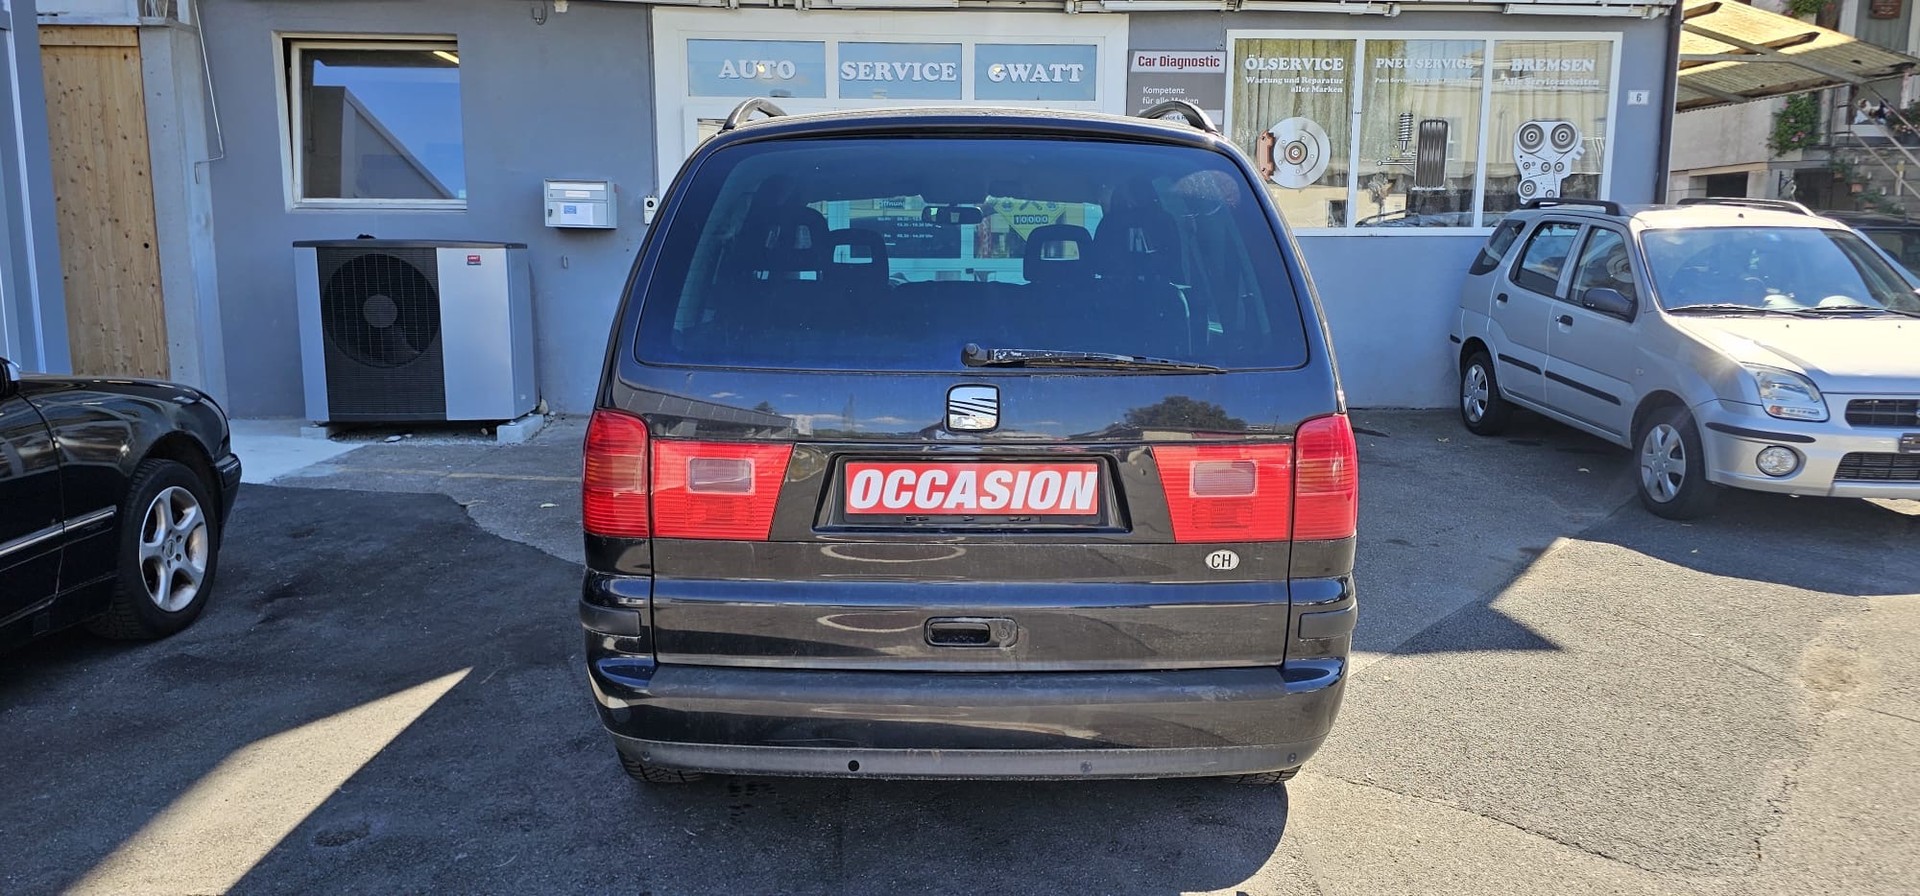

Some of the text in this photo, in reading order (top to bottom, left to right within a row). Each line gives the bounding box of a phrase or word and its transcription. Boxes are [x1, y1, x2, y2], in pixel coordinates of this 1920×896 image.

[1138, 55, 1220, 69] Car Diagnostic
[1244, 55, 1344, 71] ÖLSERVICE
[1375, 58, 1473, 69] PNEU SERVICE
[1511, 59, 1595, 71] BREMSEN
[718, 60, 1084, 83] AUTO SERVICE GWATT
[1245, 76, 1344, 85] Wartung und Reparatur
[1504, 78, 1524, 86] Alle
[1142, 86, 1185, 95] Kompetenz
[1636, 92, 1642, 103] 6
[1014, 214, 1049, 225] 10000
[850, 469, 1098, 510] OCCASION
[1211, 554, 1231, 569] CH
